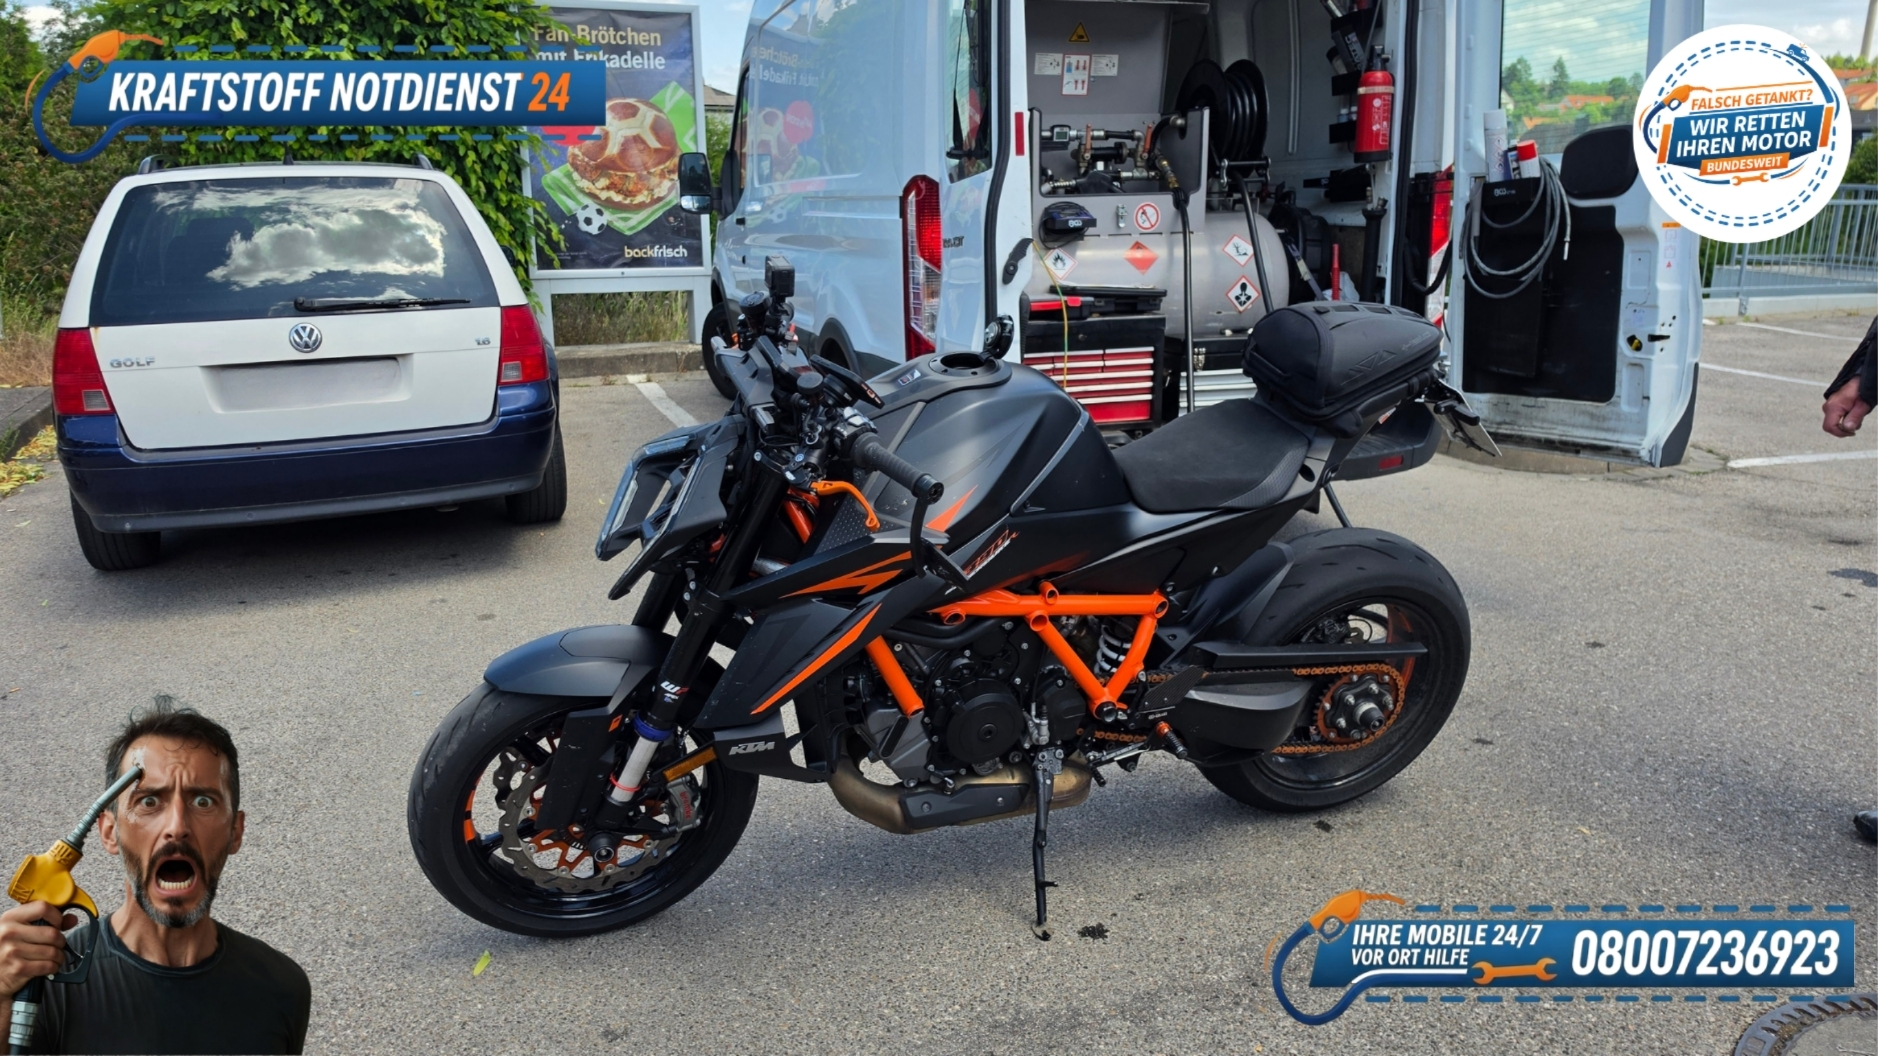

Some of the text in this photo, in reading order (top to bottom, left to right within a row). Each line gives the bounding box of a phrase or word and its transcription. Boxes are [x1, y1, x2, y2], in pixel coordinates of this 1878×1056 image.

[533, 24, 662, 46] Fan-Brötchen
[624, 245, 688, 258] backfrisch
[110, 356, 155, 369] GOLF
[728, 741, 776, 756] KTM
